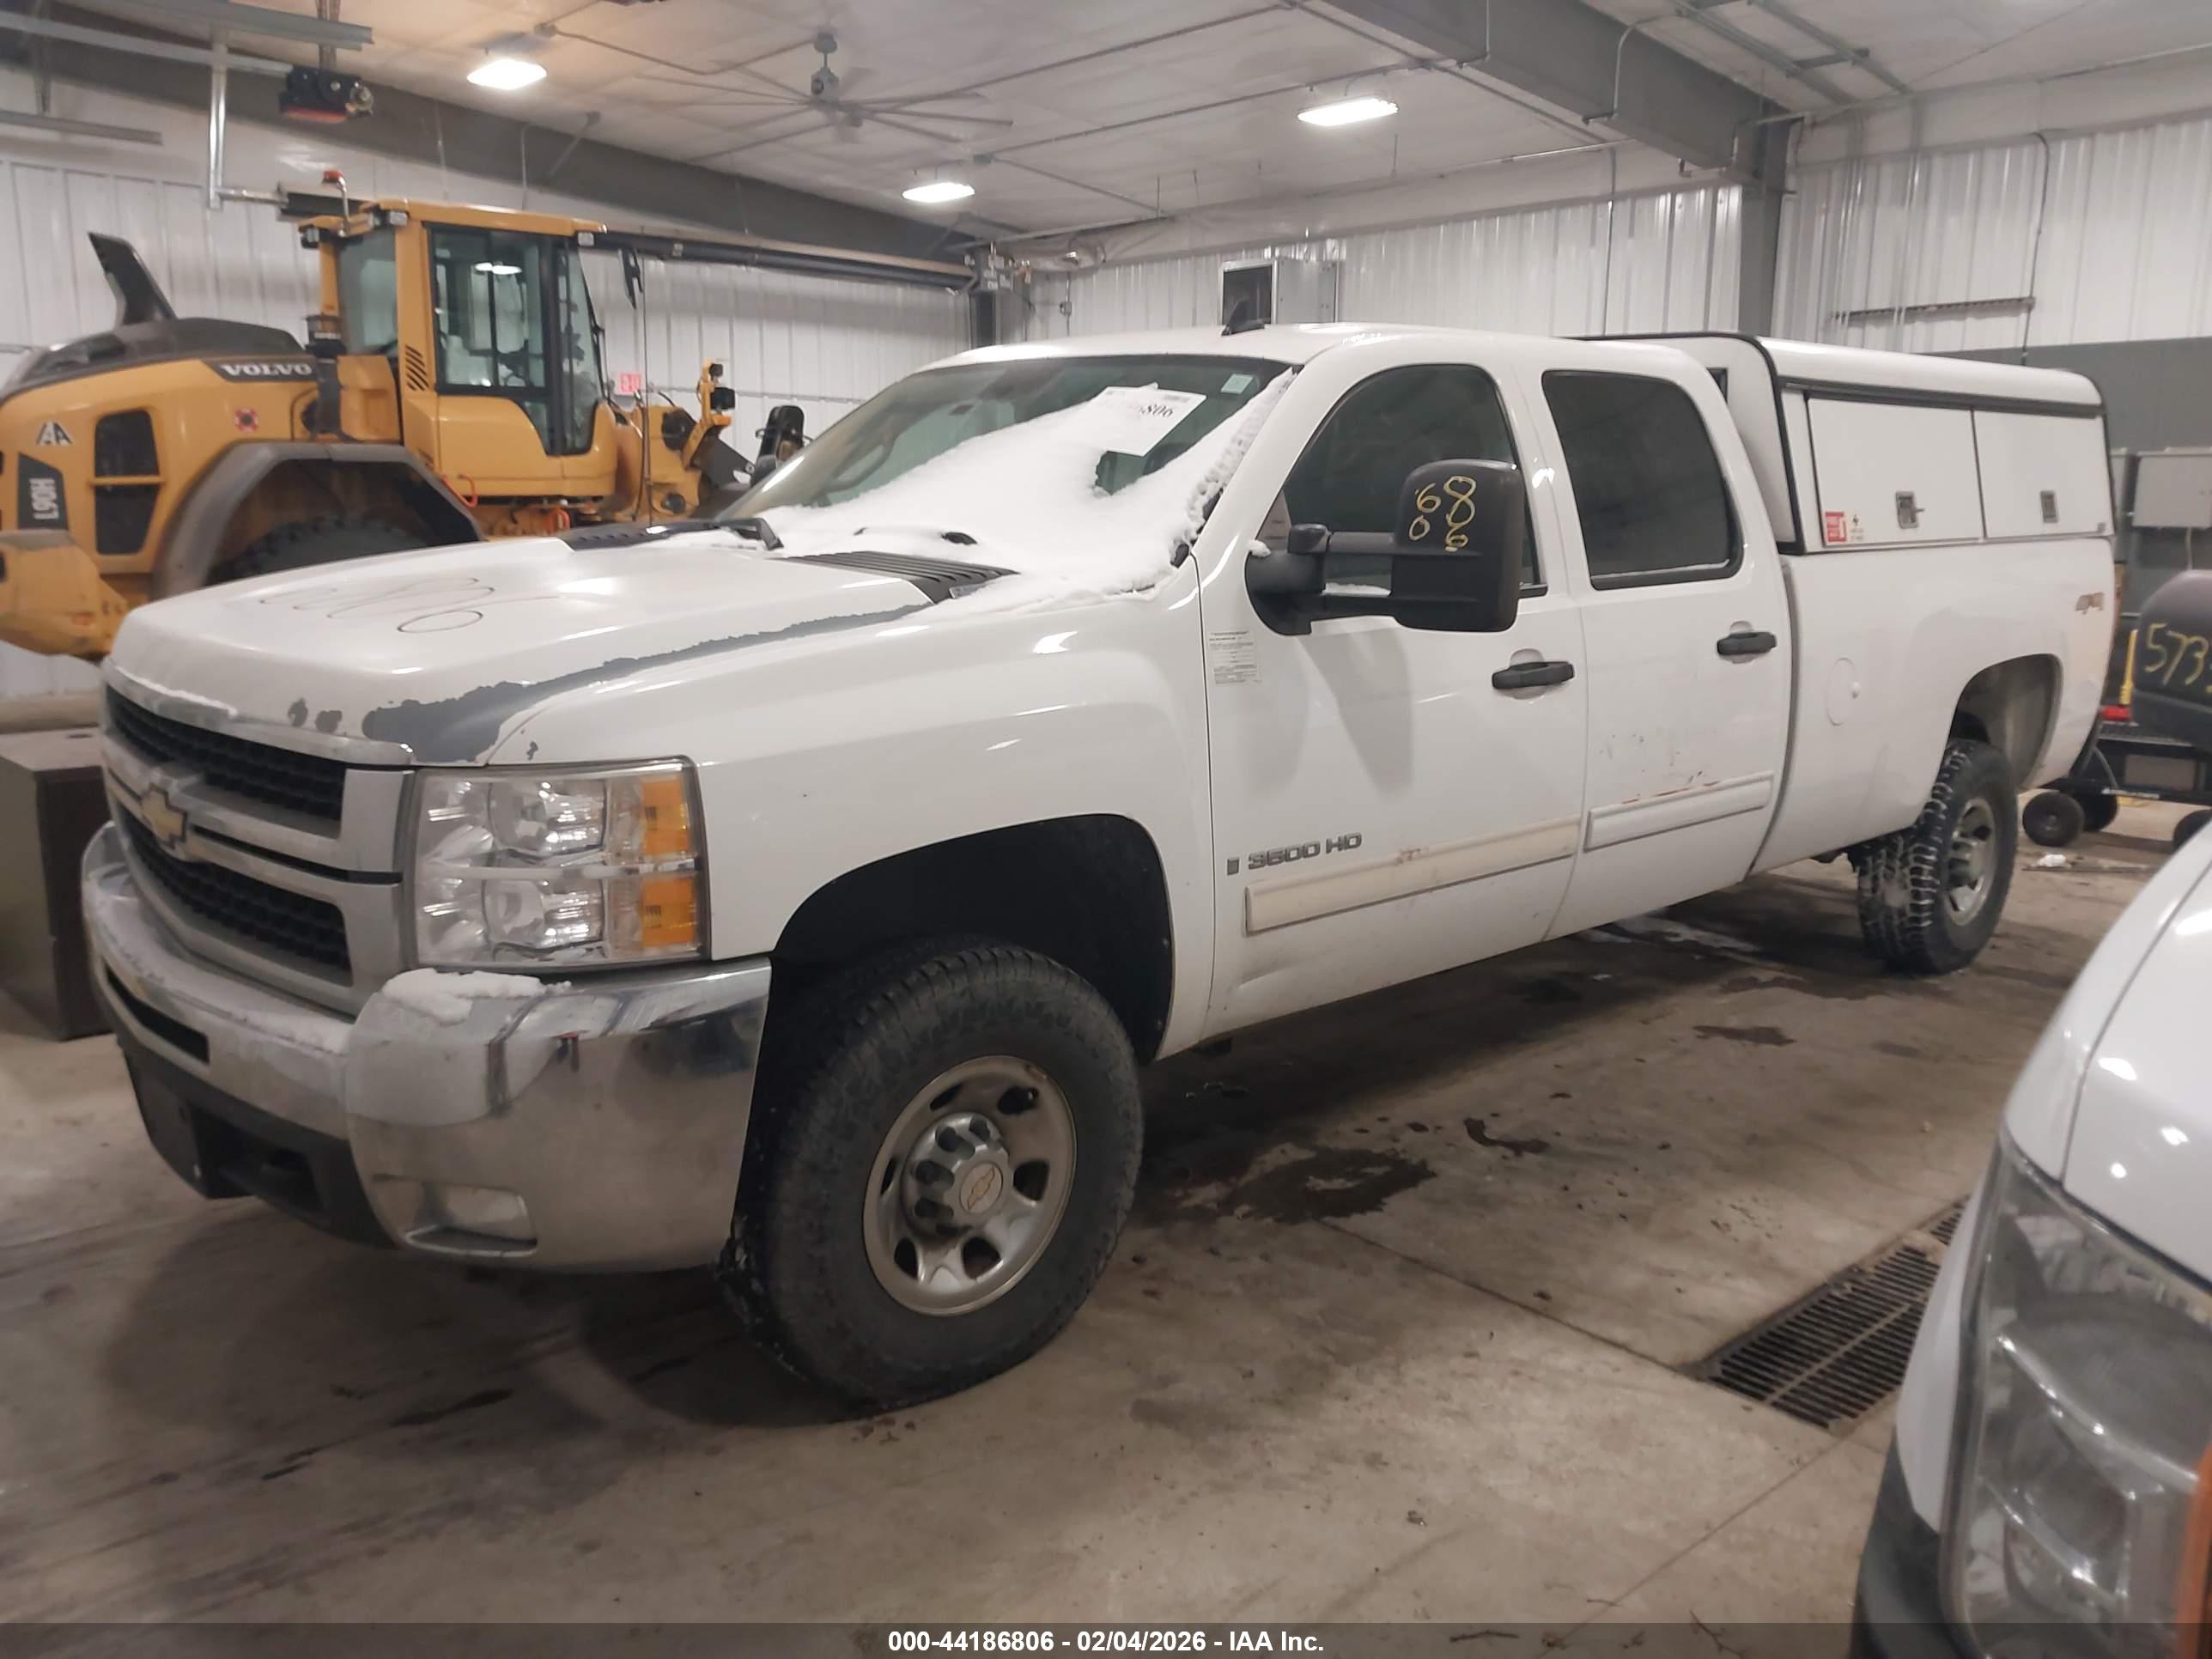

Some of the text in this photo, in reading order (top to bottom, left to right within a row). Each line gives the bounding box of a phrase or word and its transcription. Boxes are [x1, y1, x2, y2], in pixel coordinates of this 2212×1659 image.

[220, 363, 313, 376] VOLVO
[2145, 622, 2212, 692] 573
[1248, 832, 1363, 870] 3500 HD
